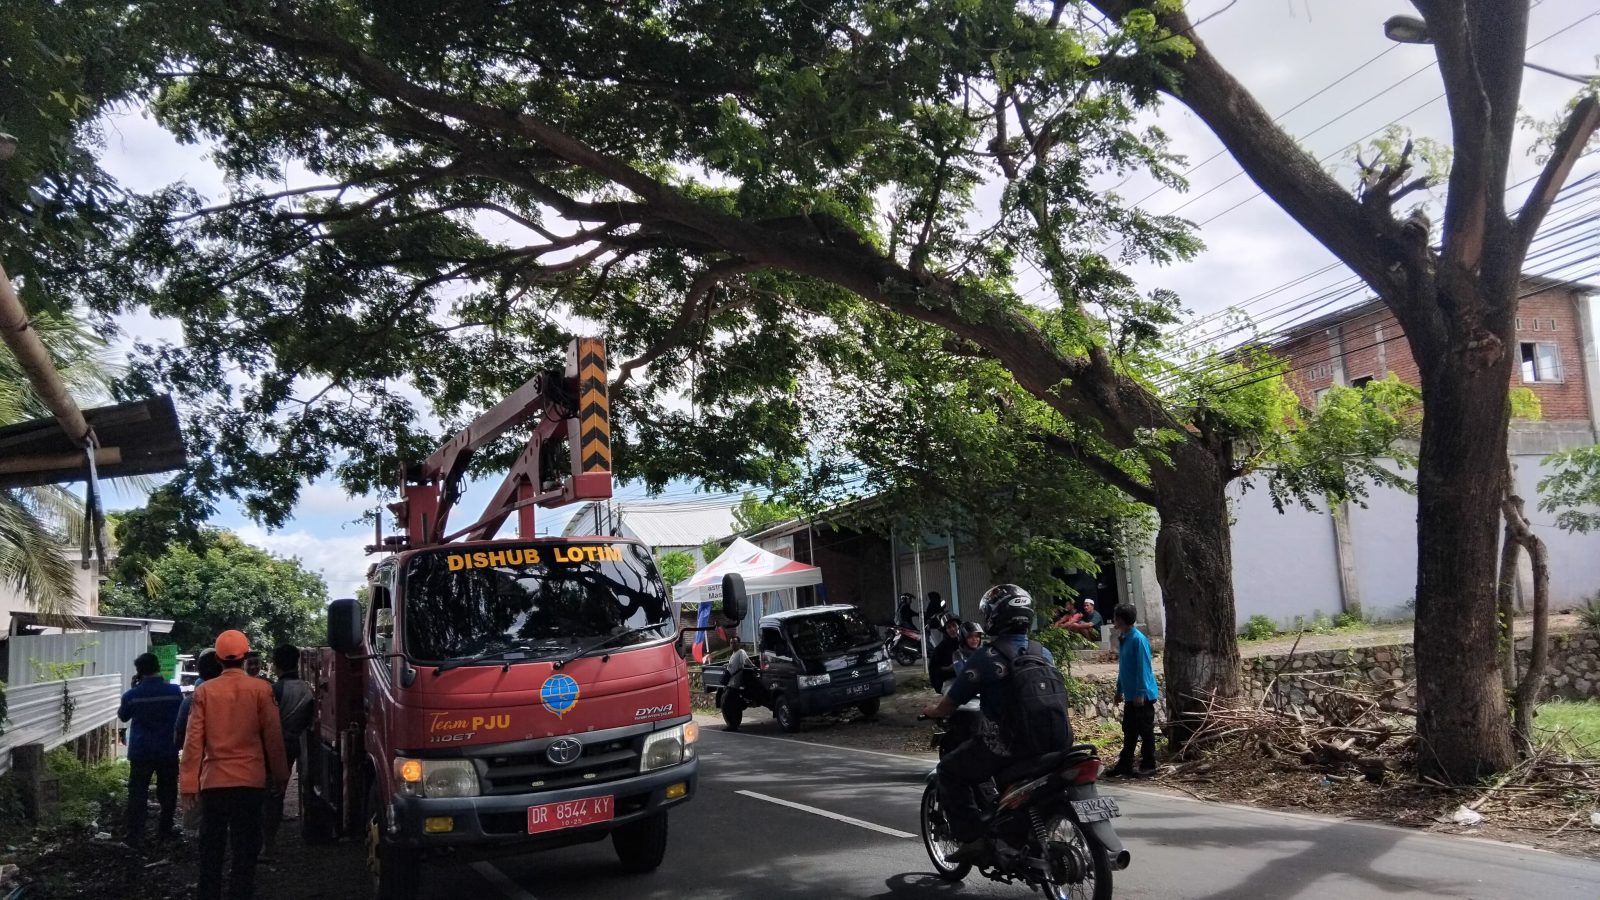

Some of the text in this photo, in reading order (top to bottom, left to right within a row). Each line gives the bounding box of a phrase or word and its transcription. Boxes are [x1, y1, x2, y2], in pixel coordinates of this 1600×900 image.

[447, 545, 623, 571] DISHUB LOTIM
[635, 703, 673, 716] DYNA
[430, 711, 511, 733] Team PJU
[532, 798, 610, 824] DR 8544 KY
